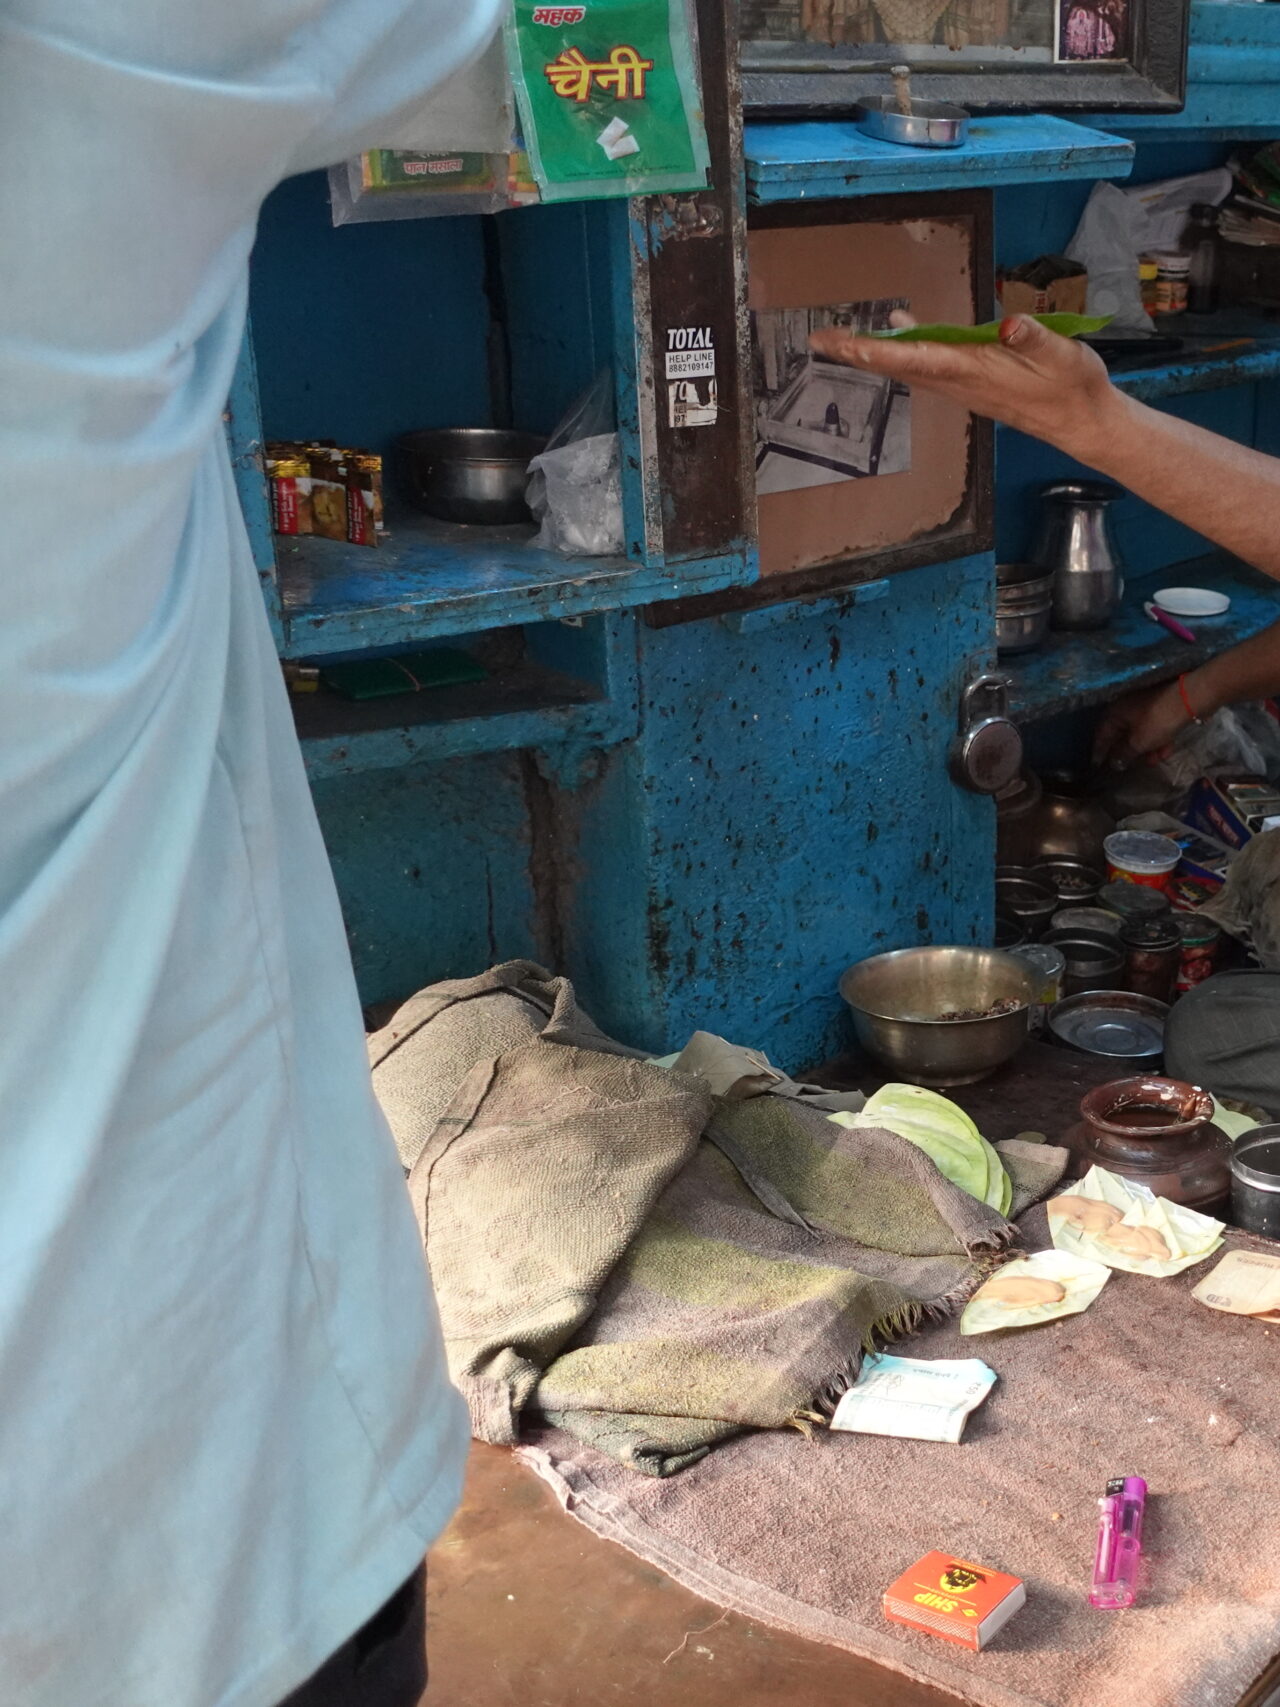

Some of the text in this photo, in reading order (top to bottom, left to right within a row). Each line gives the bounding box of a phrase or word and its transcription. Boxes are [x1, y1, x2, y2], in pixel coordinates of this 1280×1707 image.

[533, 6, 586, 27] महक
[544, 45, 653, 103] चैनी
[404, 159, 463, 175] पान मसाला
[667, 327, 713, 350] TOTAL
[669, 352, 713, 364] HELP LINE
[914, 1592, 958, 1612] SHIP
